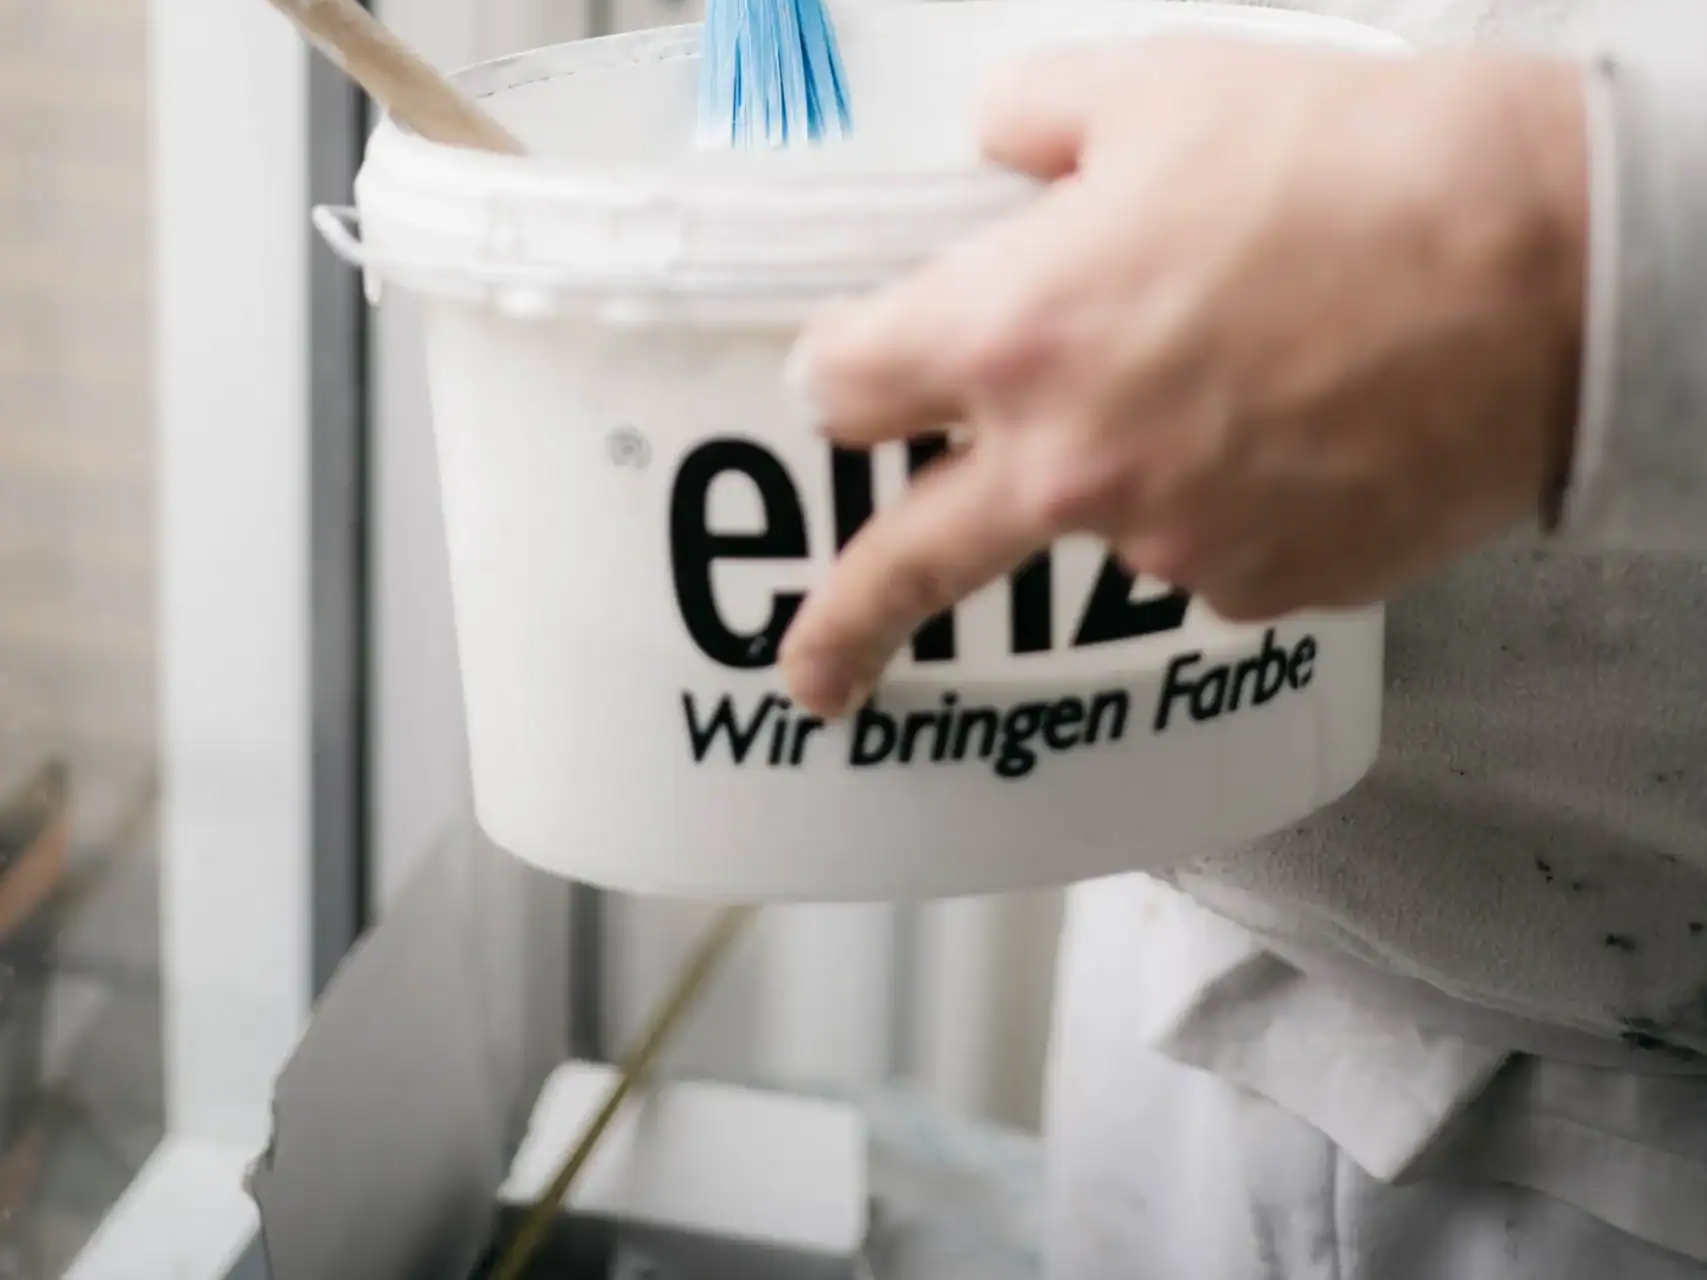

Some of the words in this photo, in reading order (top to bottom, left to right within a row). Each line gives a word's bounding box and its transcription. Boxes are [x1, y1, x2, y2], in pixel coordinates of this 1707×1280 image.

[682, 690, 822, 766] Wir
[850, 686, 1128, 778] bringen
[1154, 630, 1318, 731] Farbe
